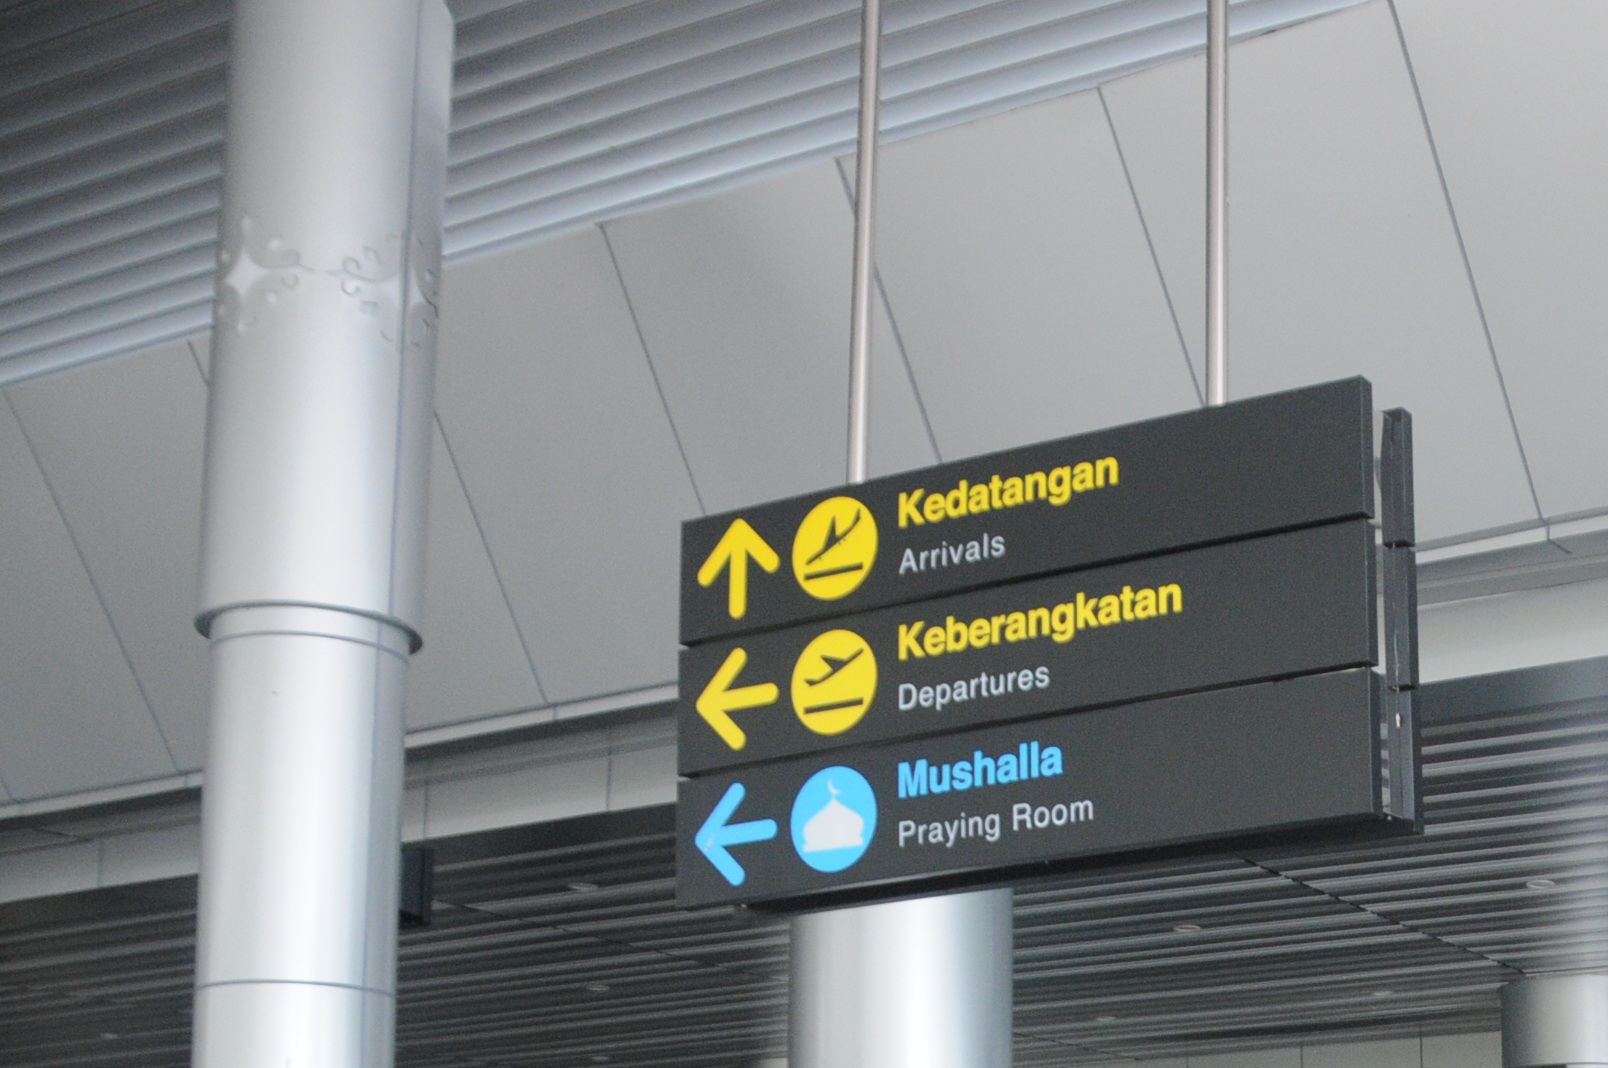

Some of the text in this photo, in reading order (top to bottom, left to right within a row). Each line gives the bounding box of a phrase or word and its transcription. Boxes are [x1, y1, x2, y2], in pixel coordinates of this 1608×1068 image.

[898, 457, 1119, 528] Kedatangan
[899, 532, 1005, 574] Arrivals
[898, 584, 1182, 661] Keberangkatan
[898, 665, 1050, 711] Departures
[898, 741, 1064, 799] Mushalla
[898, 800, 1093, 848] Praying Room
